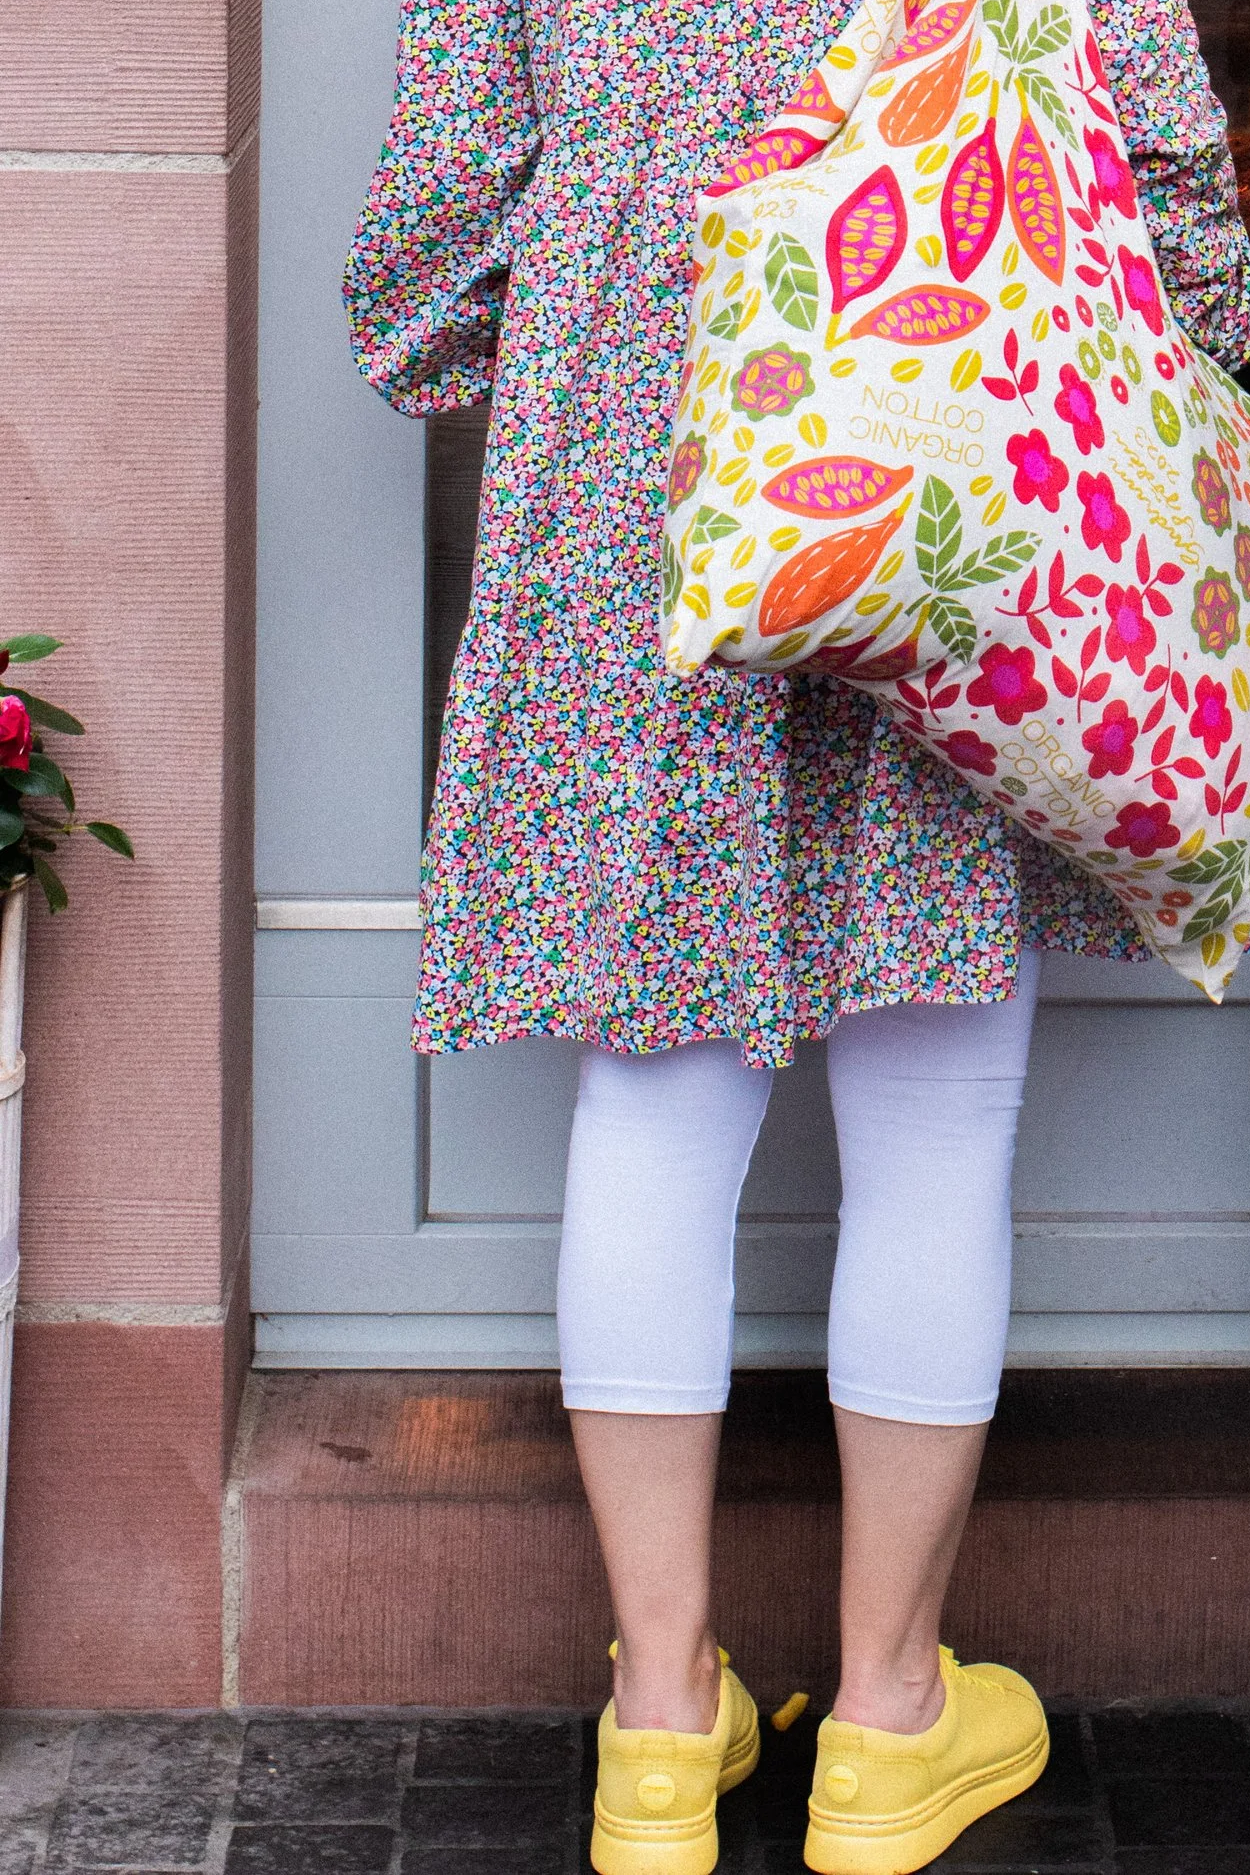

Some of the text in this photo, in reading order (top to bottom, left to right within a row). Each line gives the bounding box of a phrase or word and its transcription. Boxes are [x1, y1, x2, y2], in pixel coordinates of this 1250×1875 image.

[848, 415, 984, 468] ORGANIC
[861, 384, 985, 433] COTTON
[1000, 741, 1088, 828] COTTON
[1022, 719, 1116, 819] ORGANIC
